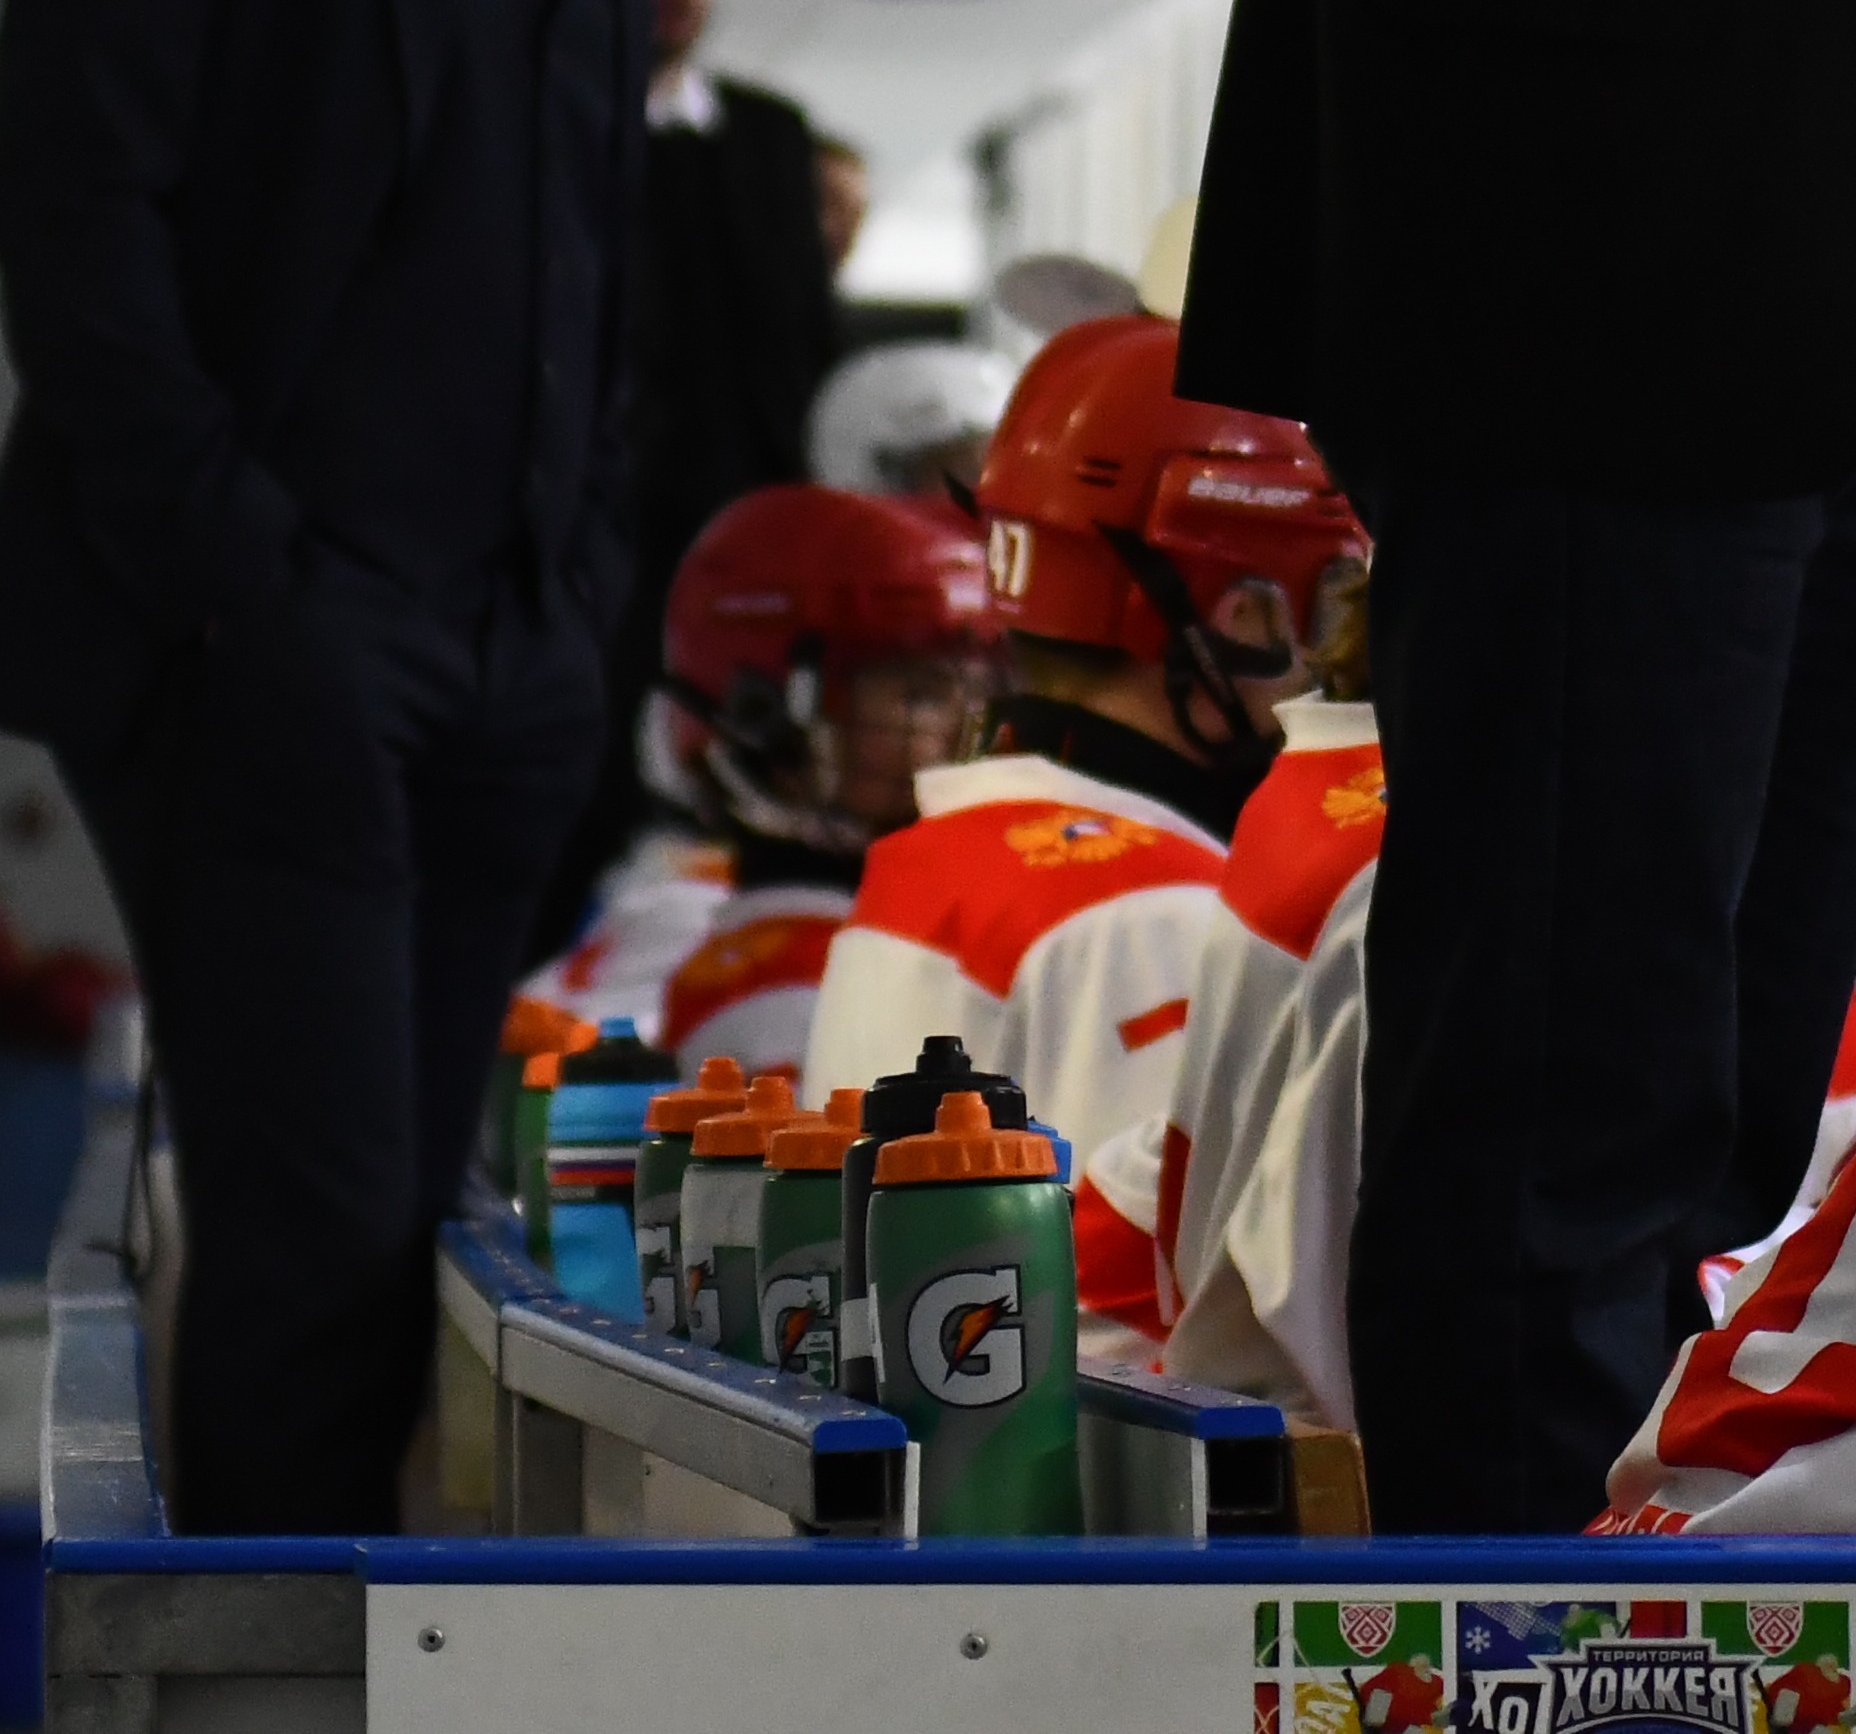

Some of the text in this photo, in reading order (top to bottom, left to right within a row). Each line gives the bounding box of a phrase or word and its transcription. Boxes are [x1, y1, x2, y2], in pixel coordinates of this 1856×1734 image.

[904, 1265, 1028, 1410] G
[1592, 1650, 1705, 1663] ТЕРРИТОРИЯ
[1556, 1666, 1739, 1728] ХОККЕЯ
